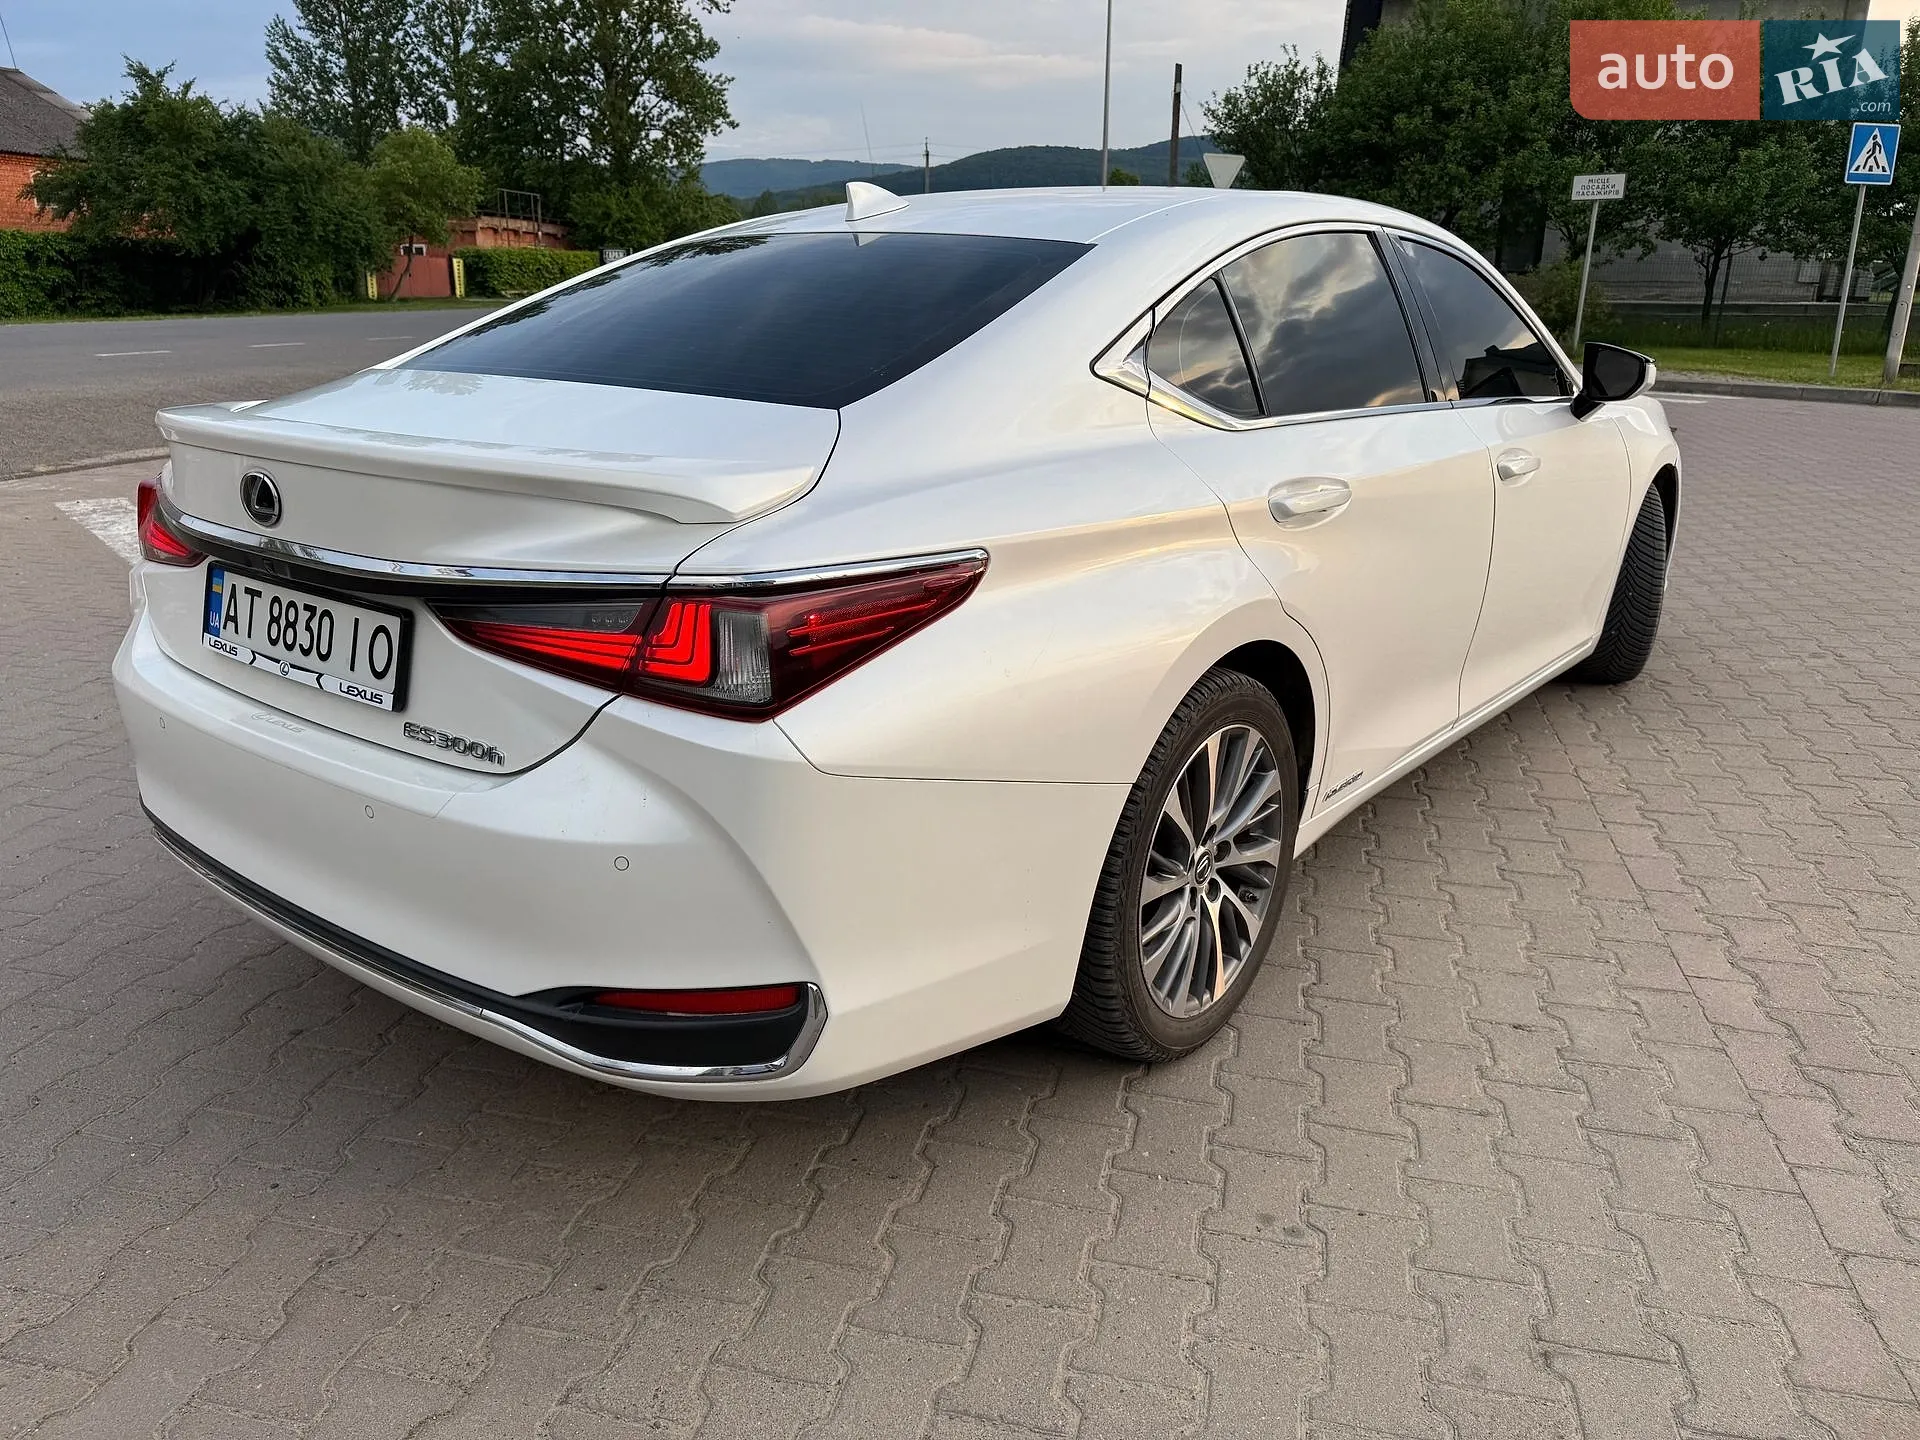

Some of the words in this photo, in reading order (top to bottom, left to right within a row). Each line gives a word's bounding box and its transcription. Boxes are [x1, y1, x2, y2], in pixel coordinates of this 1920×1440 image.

[1587, 177, 1610, 185] МІСЦЕ
[209, 610, 220, 628] UA
[222, 582, 263, 639] AT
[266, 595, 335, 662] 8830
[349, 616, 394, 680] IO
[208, 637, 238, 657] LEXUS
[339, 681, 384, 705] LEXUS
